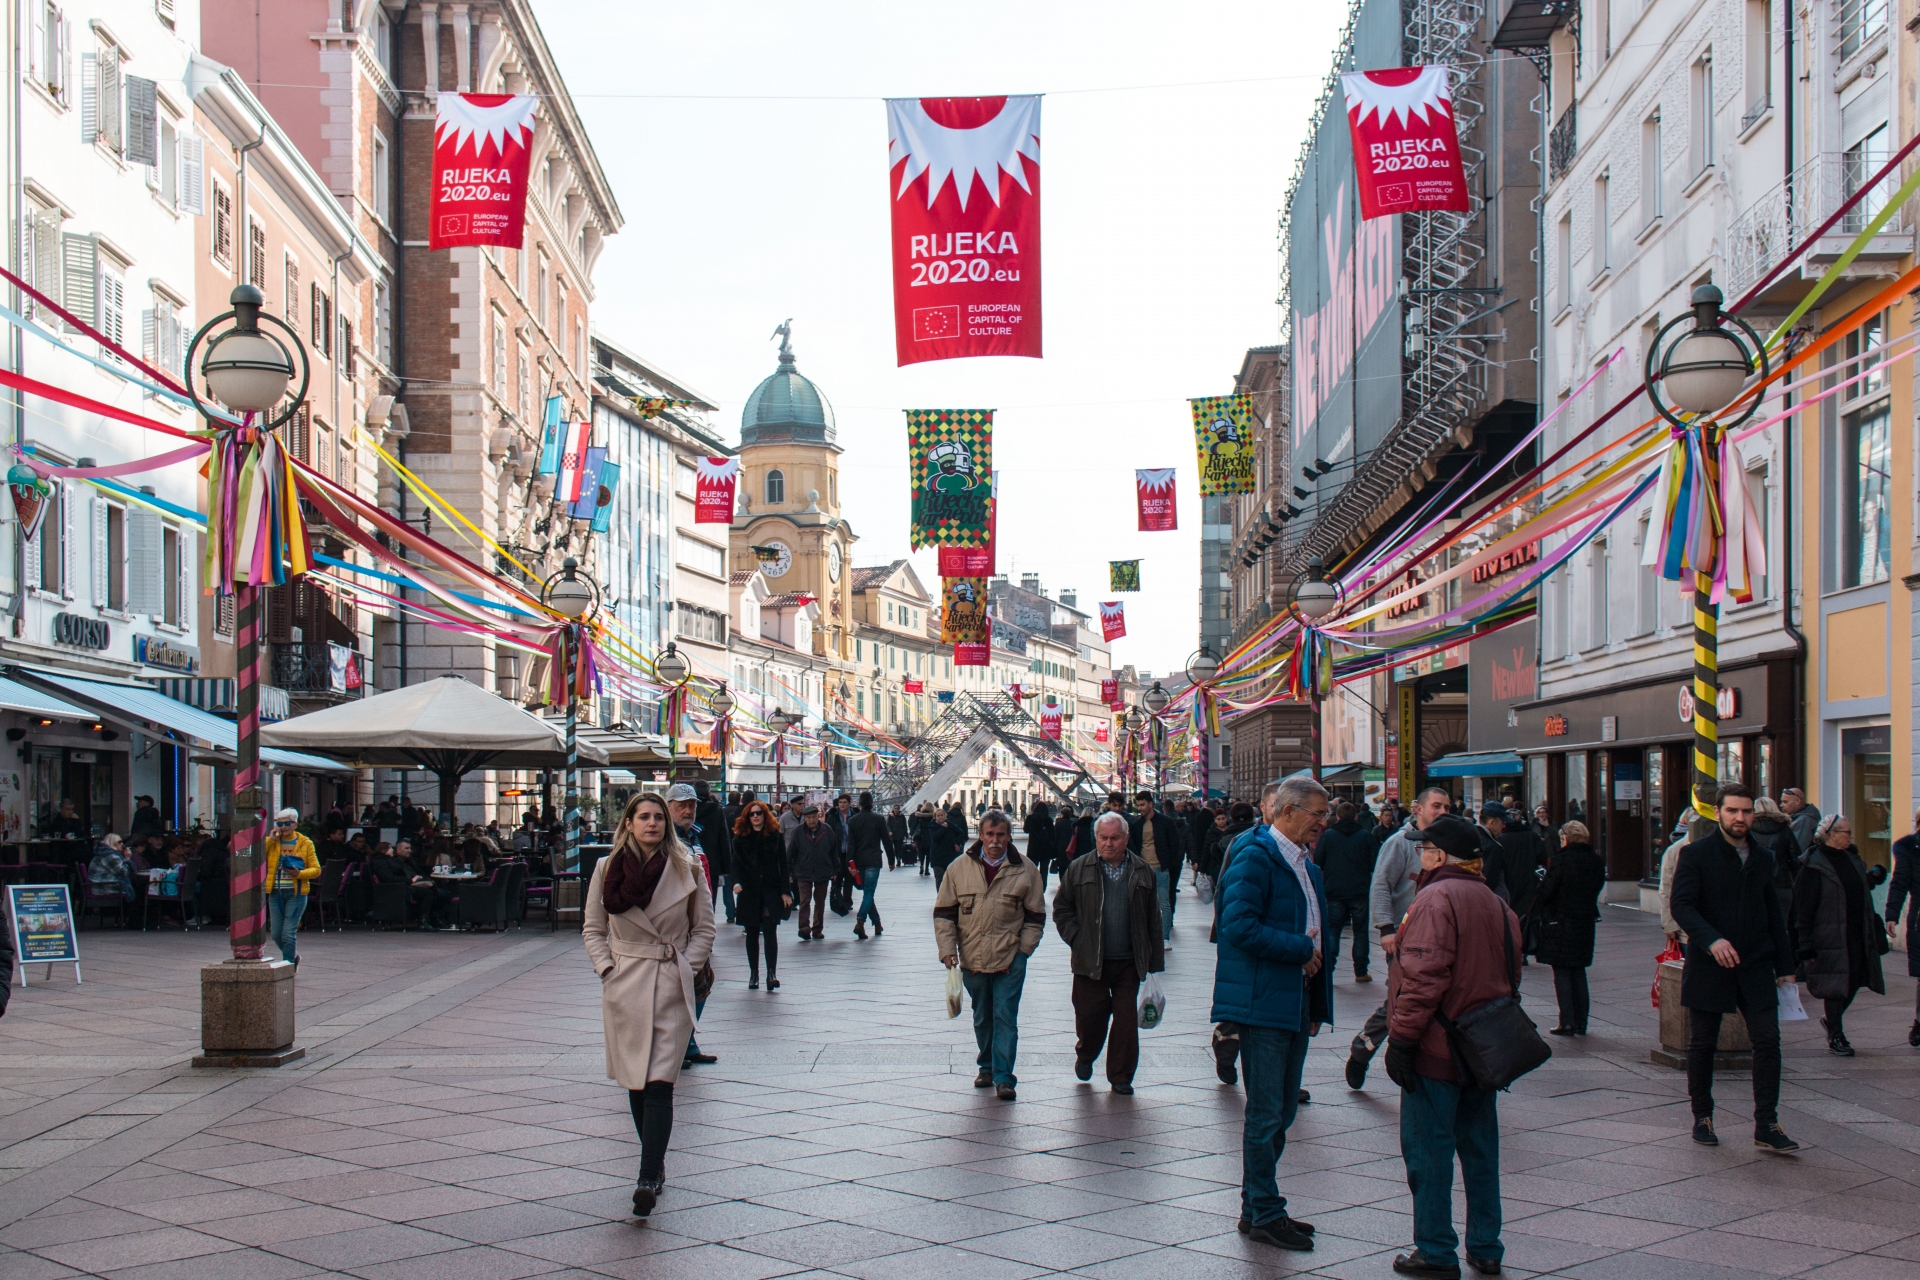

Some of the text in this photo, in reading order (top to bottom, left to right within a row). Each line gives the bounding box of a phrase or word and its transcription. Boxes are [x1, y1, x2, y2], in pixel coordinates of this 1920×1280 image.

[1370, 138, 1446, 157] RIJEKA
[1372, 154, 1450, 174] 2020.eu
[442, 168, 511, 184] RIJEKA
[440, 185, 510, 202] 2020.eu
[911, 231, 1019, 259] RIJEKA
[910, 258, 1020, 287] 2020.eu
[968, 304, 1020, 312] EUROPEAN
[968, 316, 1007, 324] CAPITAL
[968, 327, 1012, 335] CULTURE
[56, 612, 110, 650] CORSO
[145, 637, 188, 668] Gentleman
